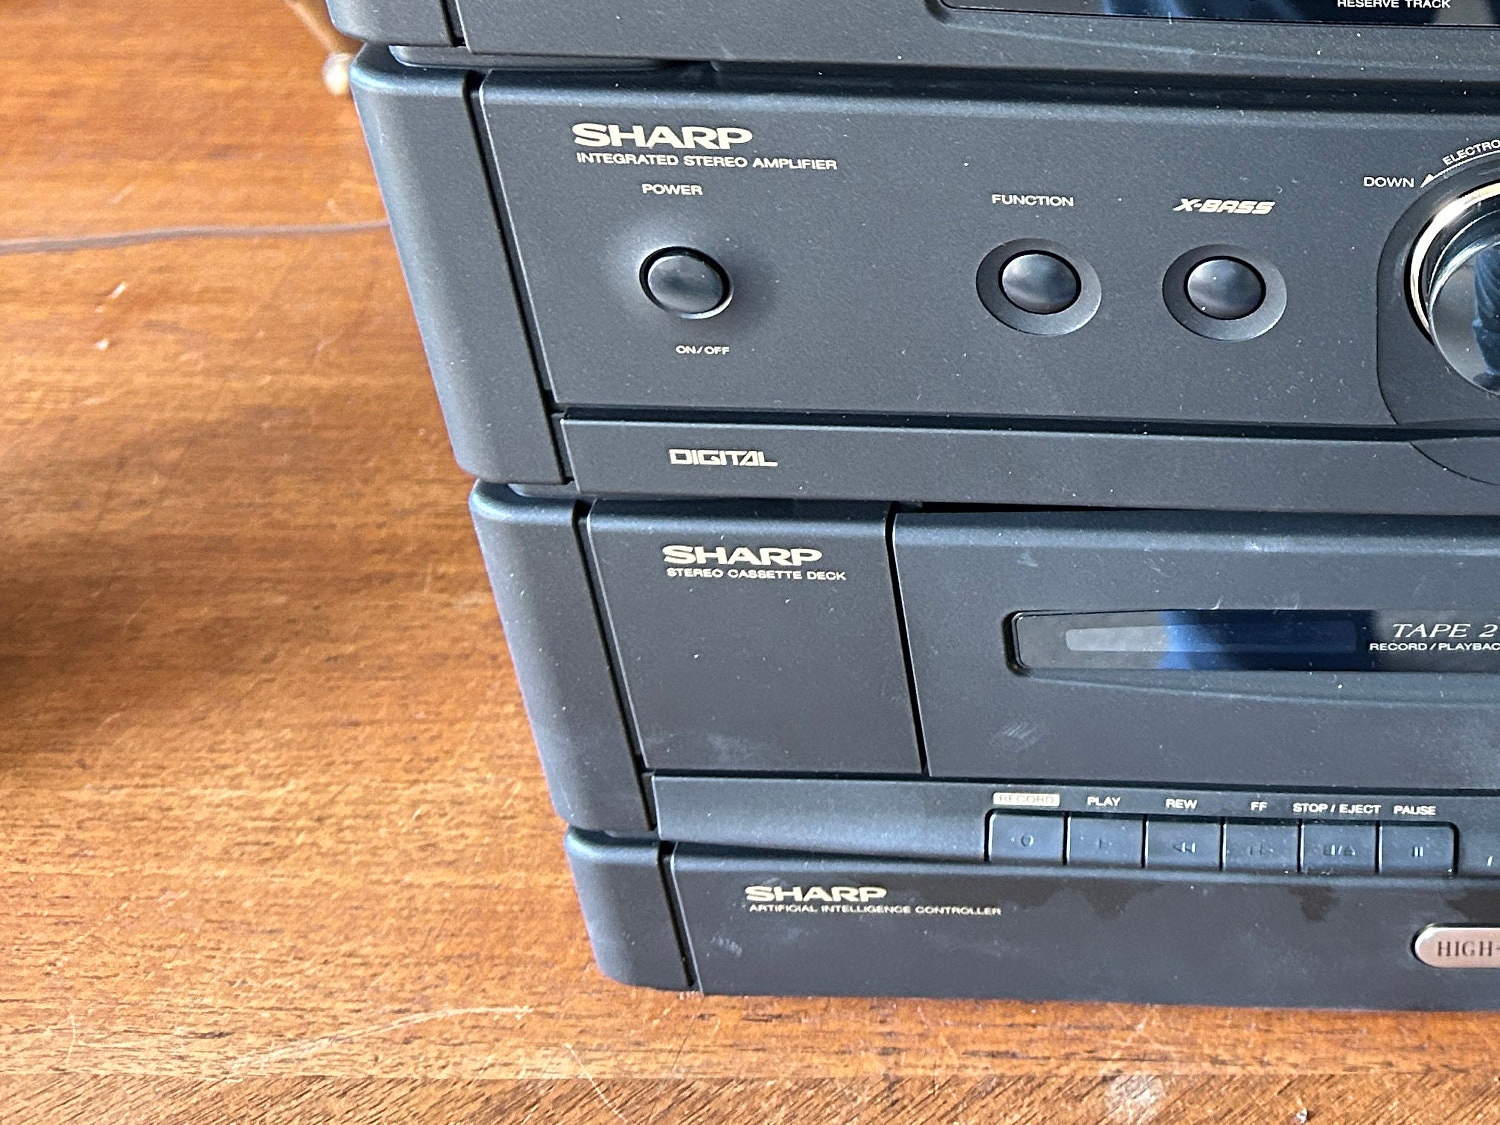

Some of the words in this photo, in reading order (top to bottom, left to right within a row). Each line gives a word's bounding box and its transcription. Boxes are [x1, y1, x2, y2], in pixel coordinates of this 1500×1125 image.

[572, 123, 753, 150] SHARP
[576, 152, 679, 167] INTEGRATED
[683, 155, 748, 168] STEREO
[752, 157, 838, 171] AMPLIFIER
[1363, 176, 1415, 188] DOWN
[642, 183, 703, 196] POWER
[991, 193, 1075, 207] FUNCTION
[1172, 197, 1276, 216] X-BASS
[675, 344, 731, 356] ON/OFF
[668, 448, 779, 467] DIGITAL
[662, 544, 823, 566] SHARP
[666, 567, 724, 579] STEREO
[727, 568, 803, 580] CASSETTE
[806, 569, 847, 581] DECK
[1393, 623, 1472, 638] TAPE
[1478, 623, 1499, 638] 2
[998, 793, 1056, 805] RECORD
[1087, 796, 1121, 808] PLAY
[1165, 798, 1198, 810] REW
[1251, 801, 1268, 812] FF
[1393, 805, 1438, 816] PAUSE
[745, 885, 887, 902] SHARP
[749, 903, 818, 914] ARTIFICIAL
[821, 904, 912, 915] INTELLIGENCE
[915, 905, 1002, 916] CONTROLLER
